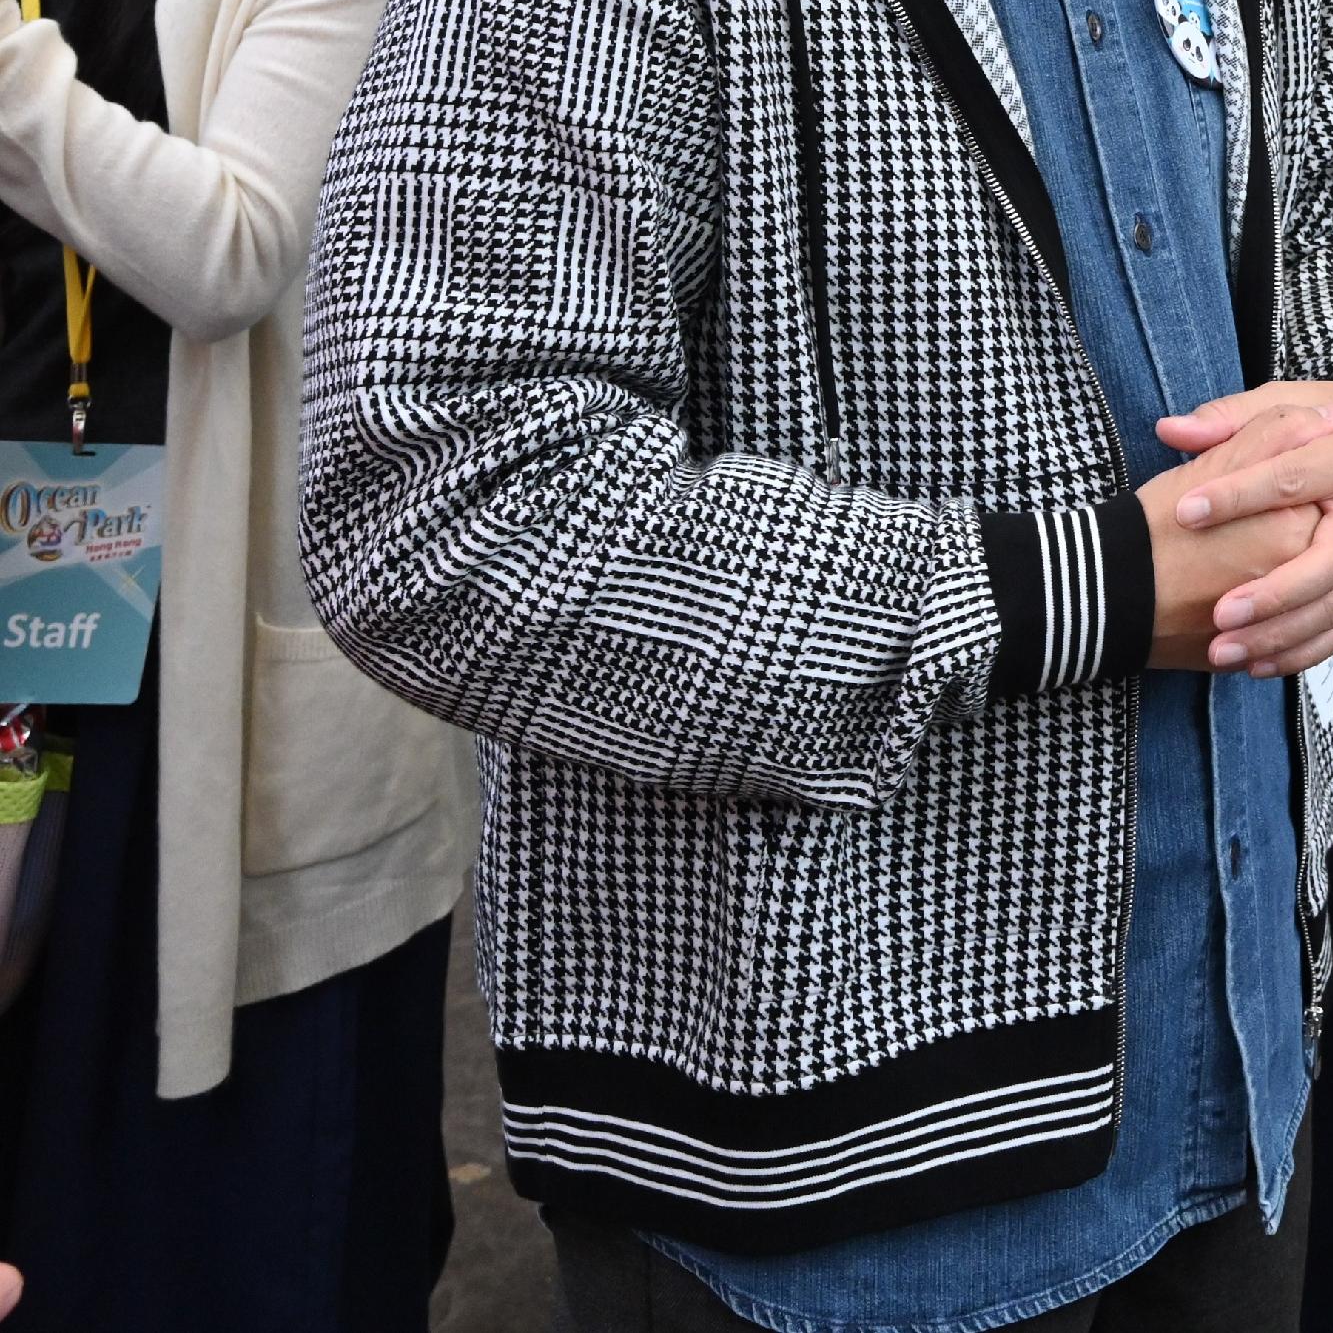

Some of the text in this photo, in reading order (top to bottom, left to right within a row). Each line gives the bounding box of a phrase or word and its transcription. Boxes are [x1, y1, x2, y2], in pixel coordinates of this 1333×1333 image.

[1, 481, 100, 533] Ocean
[63, 506, 148, 546] Park
[4, 612, 101, 649] Staff
